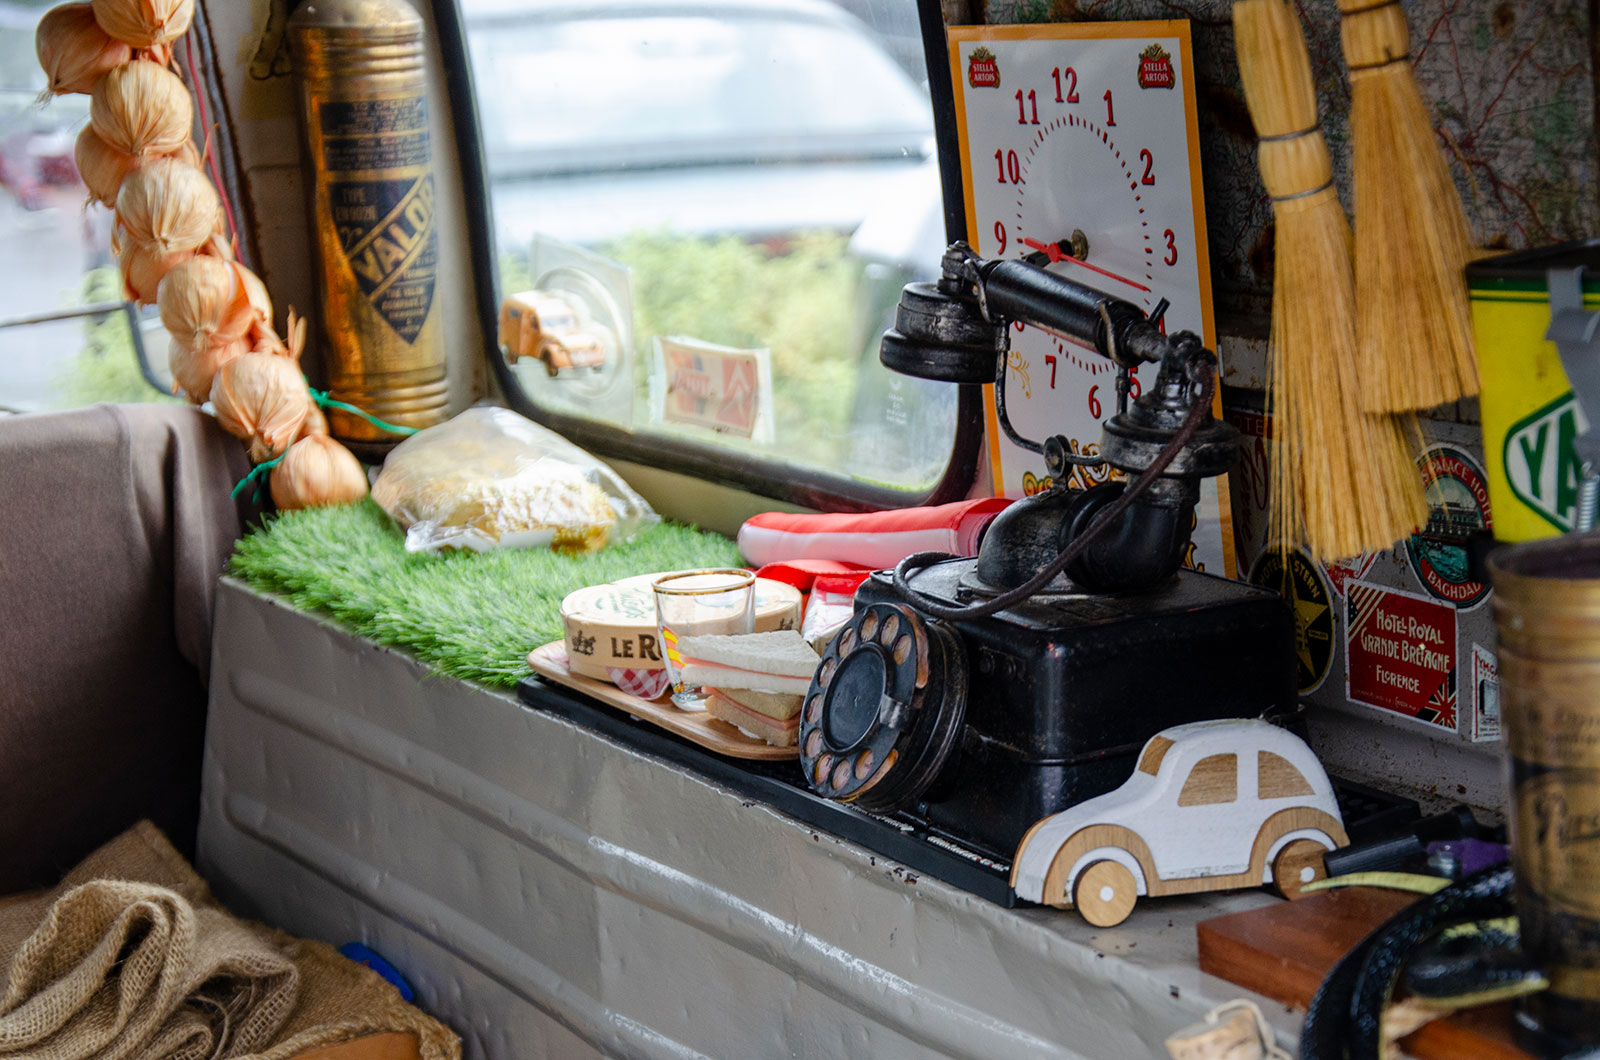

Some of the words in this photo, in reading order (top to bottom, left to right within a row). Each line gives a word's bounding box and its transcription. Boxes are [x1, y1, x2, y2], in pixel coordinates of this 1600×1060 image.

[973, 63, 994, 72] STELLA
[974, 73, 995, 82] ARTOIS
[1143, 62, 1168, 72] STELLA
[1144, 72, 1169, 82] ARTOIS
[1051, 66, 1079, 103] 12
[1014, 88, 1040, 125] 11
[1103, 89, 1116, 126] 1
[994, 149, 1020, 185] 10
[1139, 148, 1155, 185] 2
[994, 221, 1007, 256] 9
[1163, 228, 1177, 266] 3
[1045, 355, 1057, 389] 7
[1128, 366, 1141, 400] 5
[1088, 384, 1101, 419] 6
[1431, 459, 1468, 481] PALACE
[1294, 560, 1320, 599] STERN
[1427, 569, 1481, 600] BAGHDAD
[1408, 616, 1444, 644] ROYAL
[611, 637, 634, 658] LE
[1361, 626, 1399, 660] GRANDE
[1402, 640, 1450, 673] BRETAGNE
[1376, 664, 1420, 694] FLORENCE
